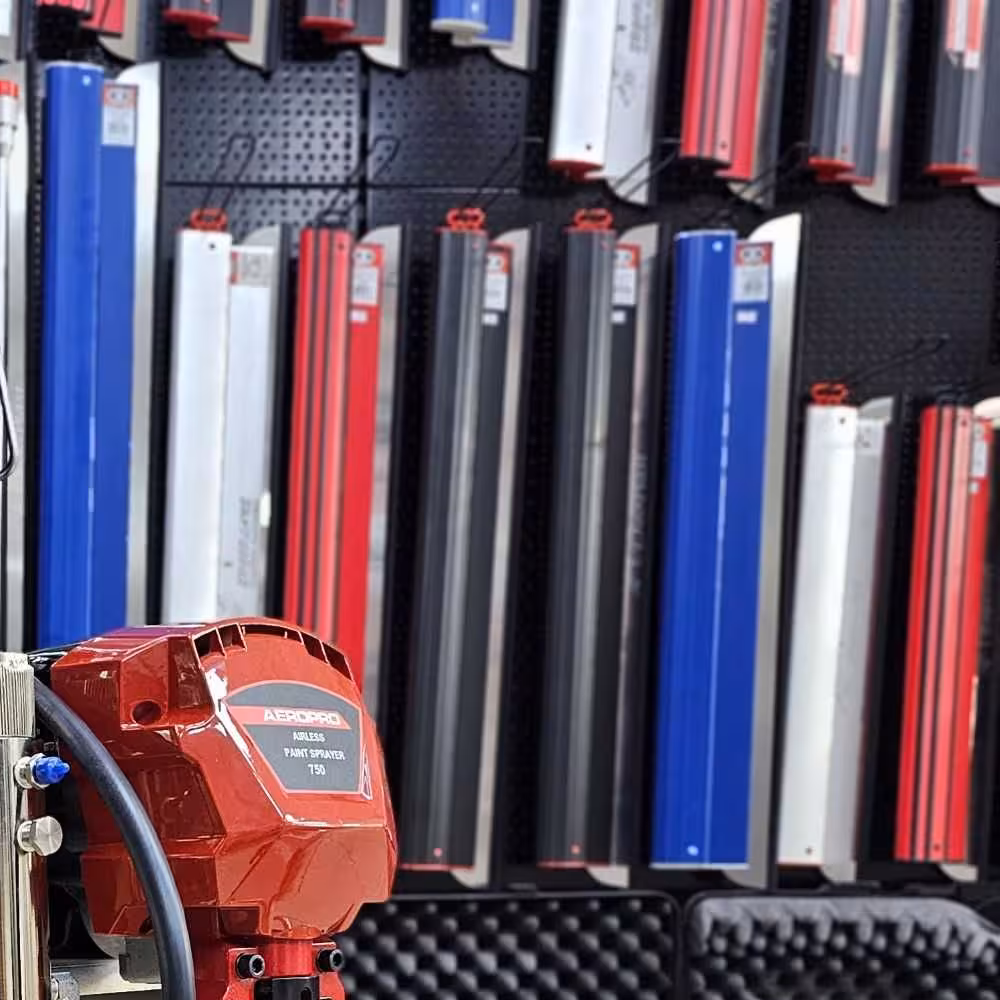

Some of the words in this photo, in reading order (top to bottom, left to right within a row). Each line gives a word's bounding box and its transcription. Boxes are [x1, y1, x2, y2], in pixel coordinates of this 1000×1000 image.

[264, 709, 341, 725] AEROPRO
[293, 732, 325, 742] AIRLESS
[284, 748, 308, 758] PAINT
[309, 749, 346, 760] SPRAYER
[308, 764, 326, 775] 750
